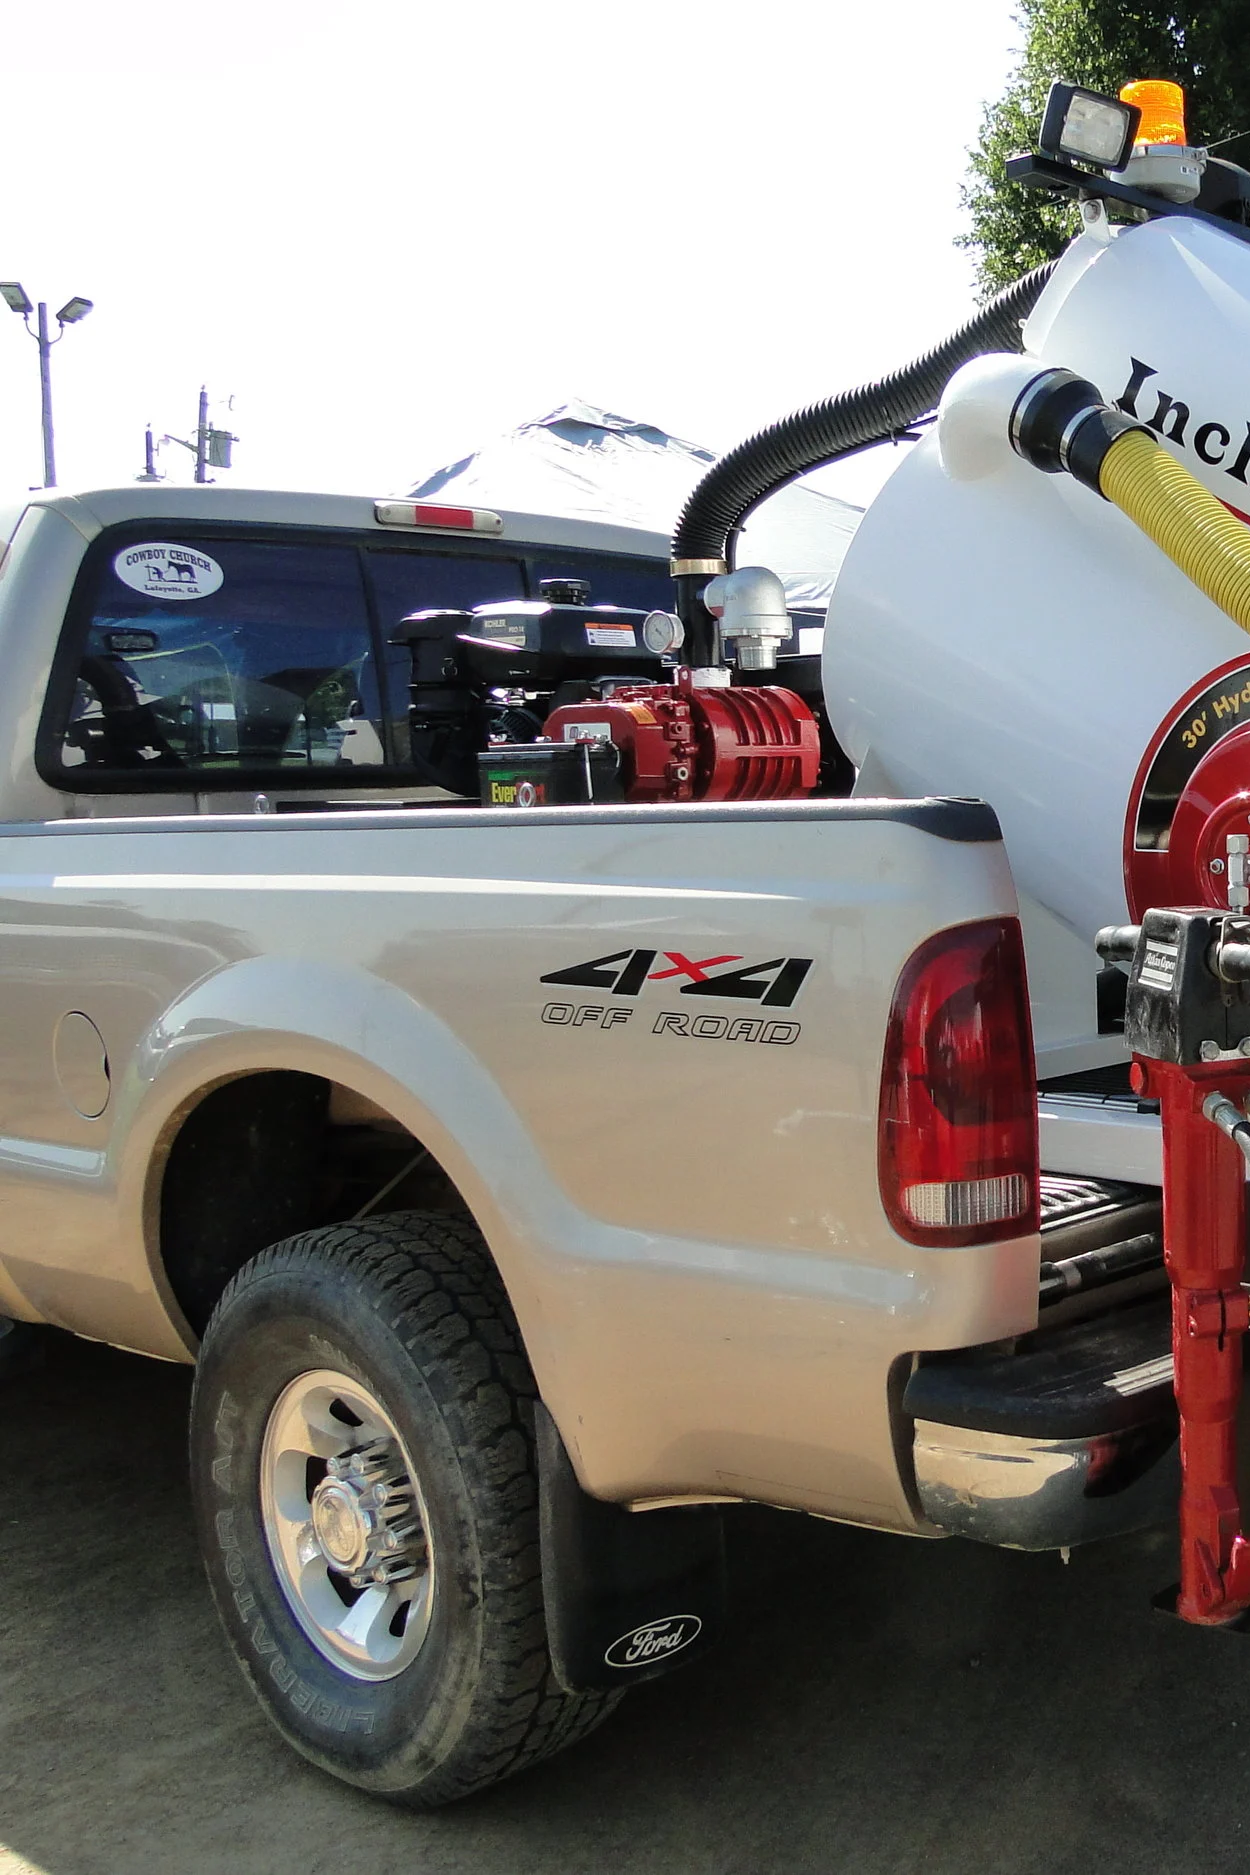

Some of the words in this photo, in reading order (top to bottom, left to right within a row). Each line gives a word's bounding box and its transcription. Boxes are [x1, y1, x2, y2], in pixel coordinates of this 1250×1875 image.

[125, 549, 167, 566] COWBOY
[169, 549, 212, 573] CHURCH
[541, 1002, 634, 1030] OFF
[652, 1011, 802, 1046] ROAD
